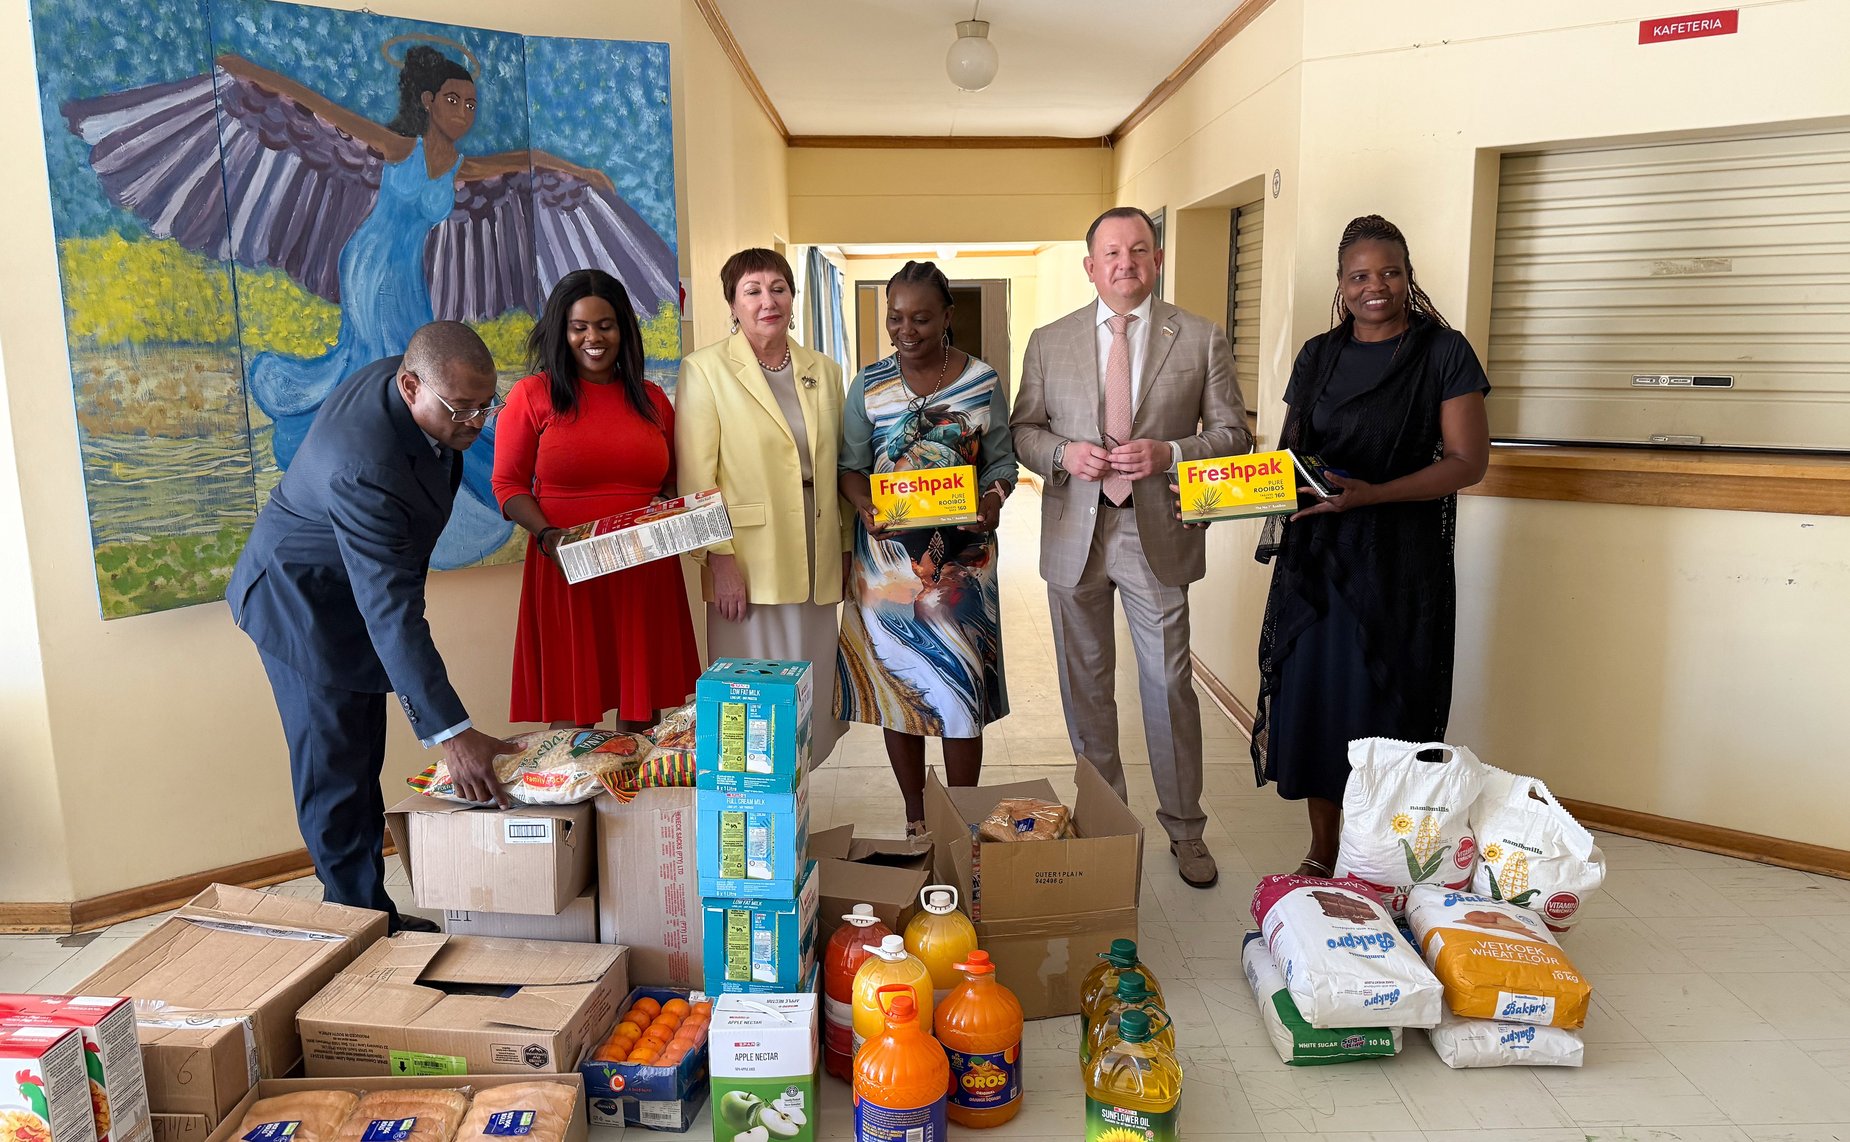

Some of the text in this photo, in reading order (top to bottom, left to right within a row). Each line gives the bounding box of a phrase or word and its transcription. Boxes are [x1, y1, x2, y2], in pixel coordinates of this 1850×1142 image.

[1653, 18, 1722, 36] KAFETERIA
[1187, 457, 1282, 483] Freshpak
[879, 472, 965, 496] Freshpak
[1253, 485, 1285, 493] ROOIBOS
[938, 498, 966, 506] ROOIBOS
[730, 688, 760, 696] LOW FAT MILK
[525, 775, 546, 784] Family
[1410, 805, 1449, 813] namibmills
[1502, 838, 1543, 855] namibmills
[1549, 901, 1577, 910] VITAMIN
[1326, 932, 1396, 953] Bakpro
[1476, 940, 1548, 956] VETKOEK
[1470, 947, 1514, 959] WHEAT
[1517, 952, 1560, 966] FLOUR
[1552, 972, 1579, 984] 10 kg
[1363, 988, 1401, 1007] Bakpro
[1502, 1000, 1547, 1016] Bakpro
[1380, 1038, 1390, 1047] kg
[1500, 1026, 1536, 1045] Bakpro
[734, 1052, 779, 1062] APPLE NECTAR
[177, 1050, 198, 1085] 6
[962, 1073, 1006, 1089] OROS
[1101, 1108, 1150, 1127] SUNFLOWER OIL
